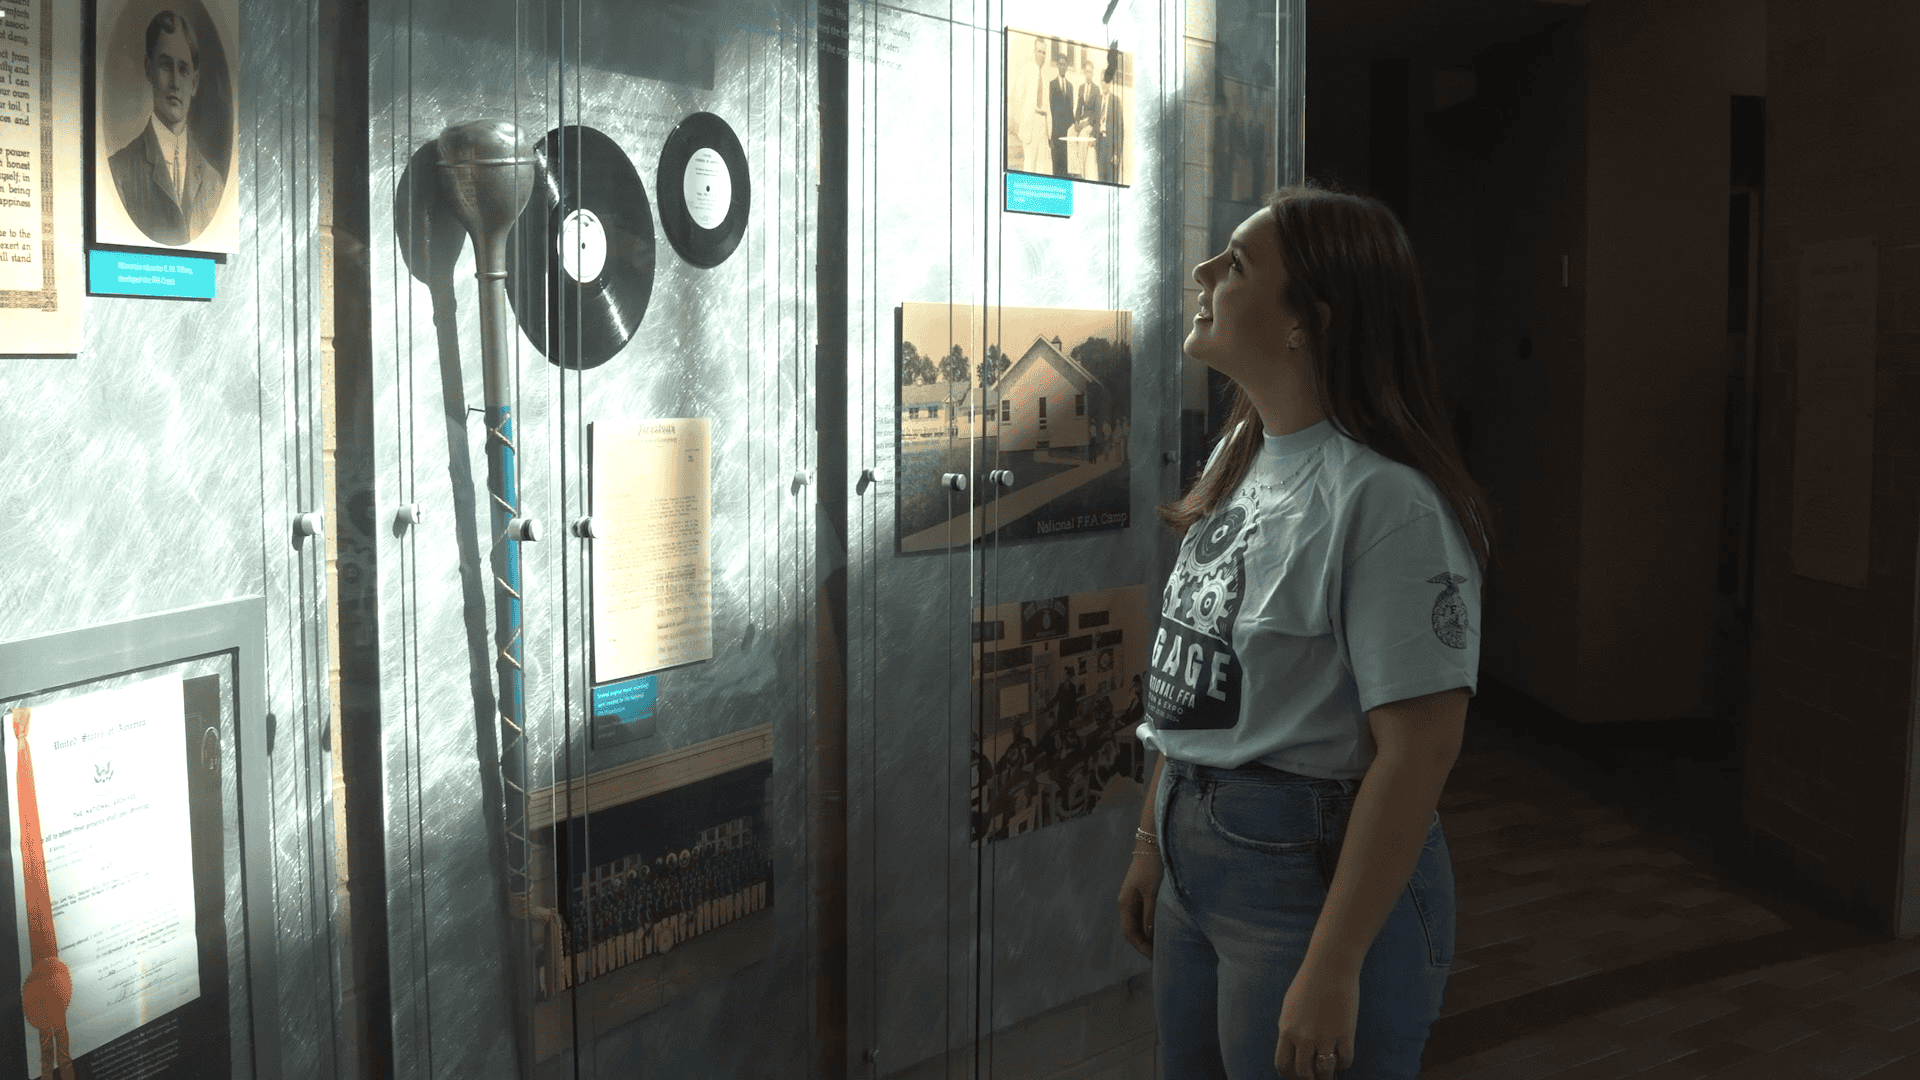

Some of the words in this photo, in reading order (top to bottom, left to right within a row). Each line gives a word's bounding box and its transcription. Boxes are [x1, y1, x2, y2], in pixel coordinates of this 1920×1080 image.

[11, 51, 30, 63] from
[14, 65, 30, 75] and
[15, 78, 30, 87] can
[12, 90, 30, 100] own
[14, 115, 30, 126] and
[5, 148, 31, 160] power
[6, 160, 31, 171] honest
[8, 183, 31, 198] being
[9, 228, 17, 238] to
[19, 228, 31, 239] the
[0, 241, 20, 251] exert
[21, 243, 32, 251] an
[11, 252, 32, 263] stand
[1036, 516, 1075, 534] National
[1100, 512, 1128, 527] Camp
[1176, 688, 1196, 708] FFA
[1163, 701, 1184, 715] EXPO
[53, 736, 78, 751] United
[81, 732, 105, 743] States
[118, 719, 147, 732] America
